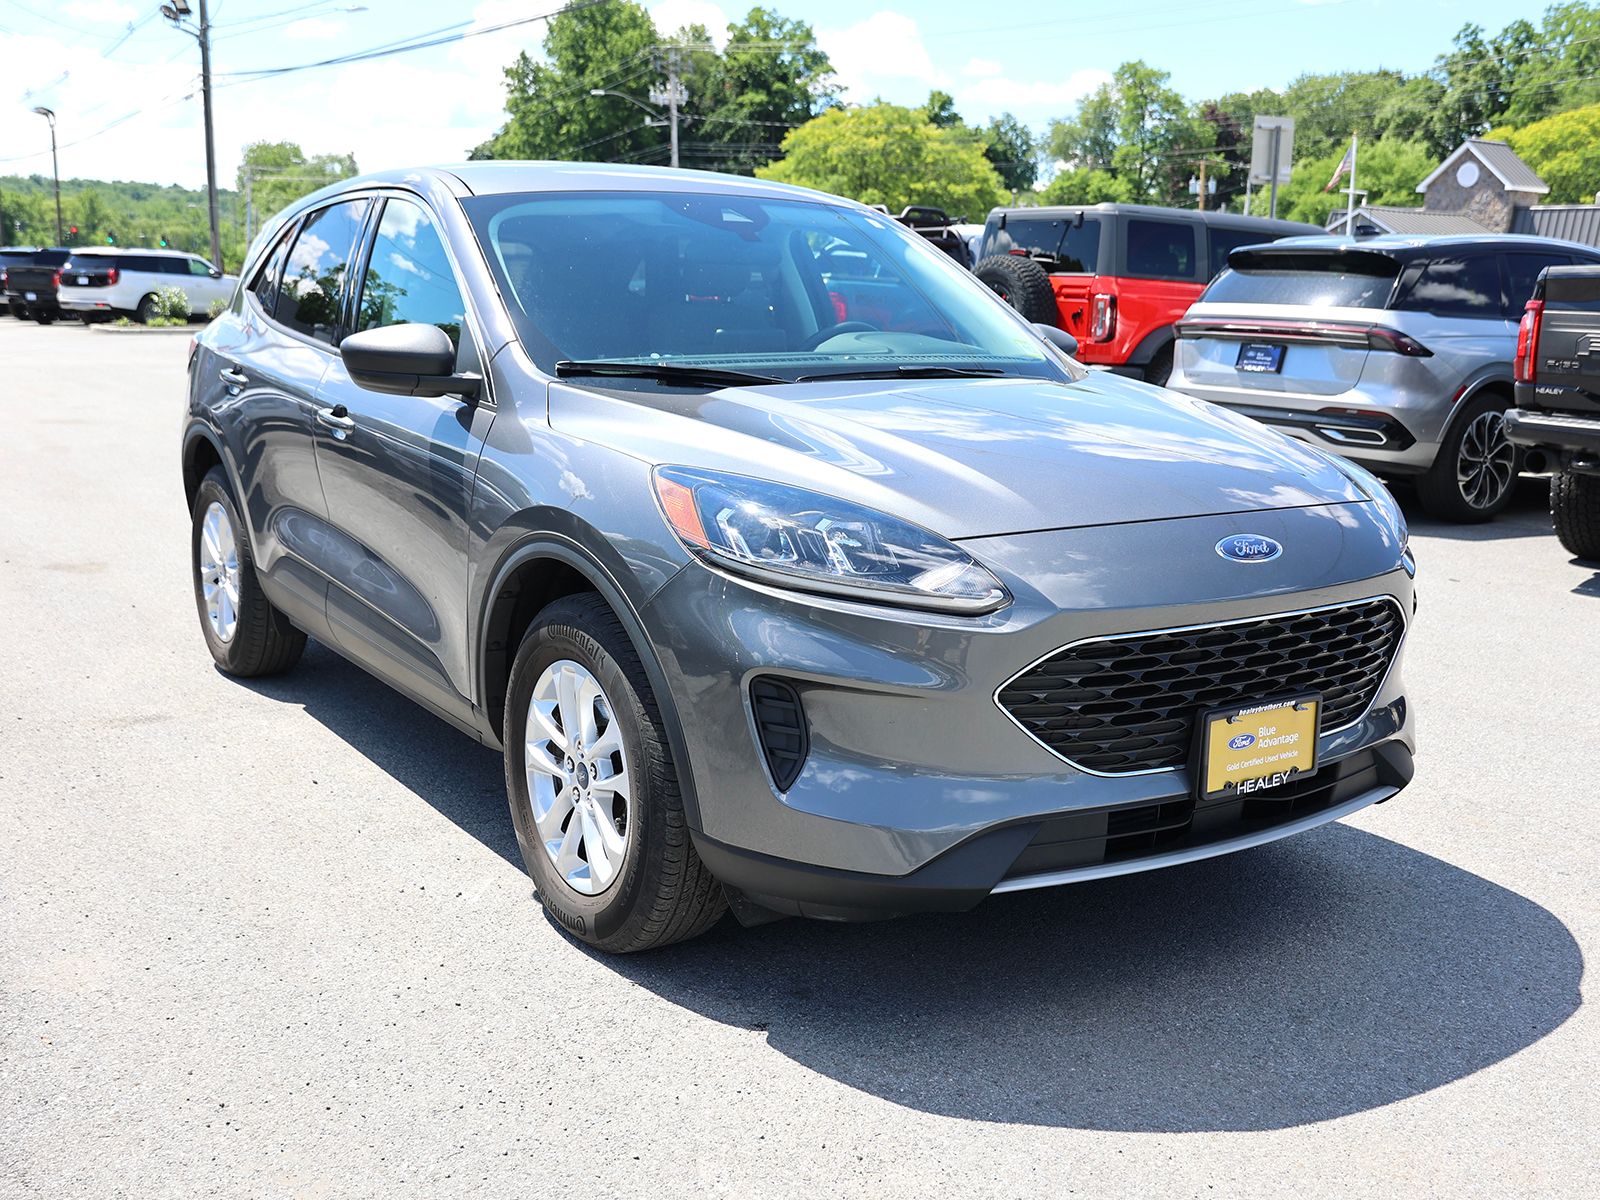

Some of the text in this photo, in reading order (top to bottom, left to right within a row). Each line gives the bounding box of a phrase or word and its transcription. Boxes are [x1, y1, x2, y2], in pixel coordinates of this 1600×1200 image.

[1535, 387, 1564, 396] HEALEY
[1233, 538, 1270, 556] Ford
[547, 624, 600, 661] Continental
[1238, 700, 1296, 716] healeybrothers.com
[1257, 732, 1299, 749] Advantage
[1258, 726, 1277, 738] Blue
[1231, 735, 1253, 749] Ford
[1226, 750, 1299, 772] Gold Certified Used Vehicle
[1237, 771, 1290, 795] HEALEY
